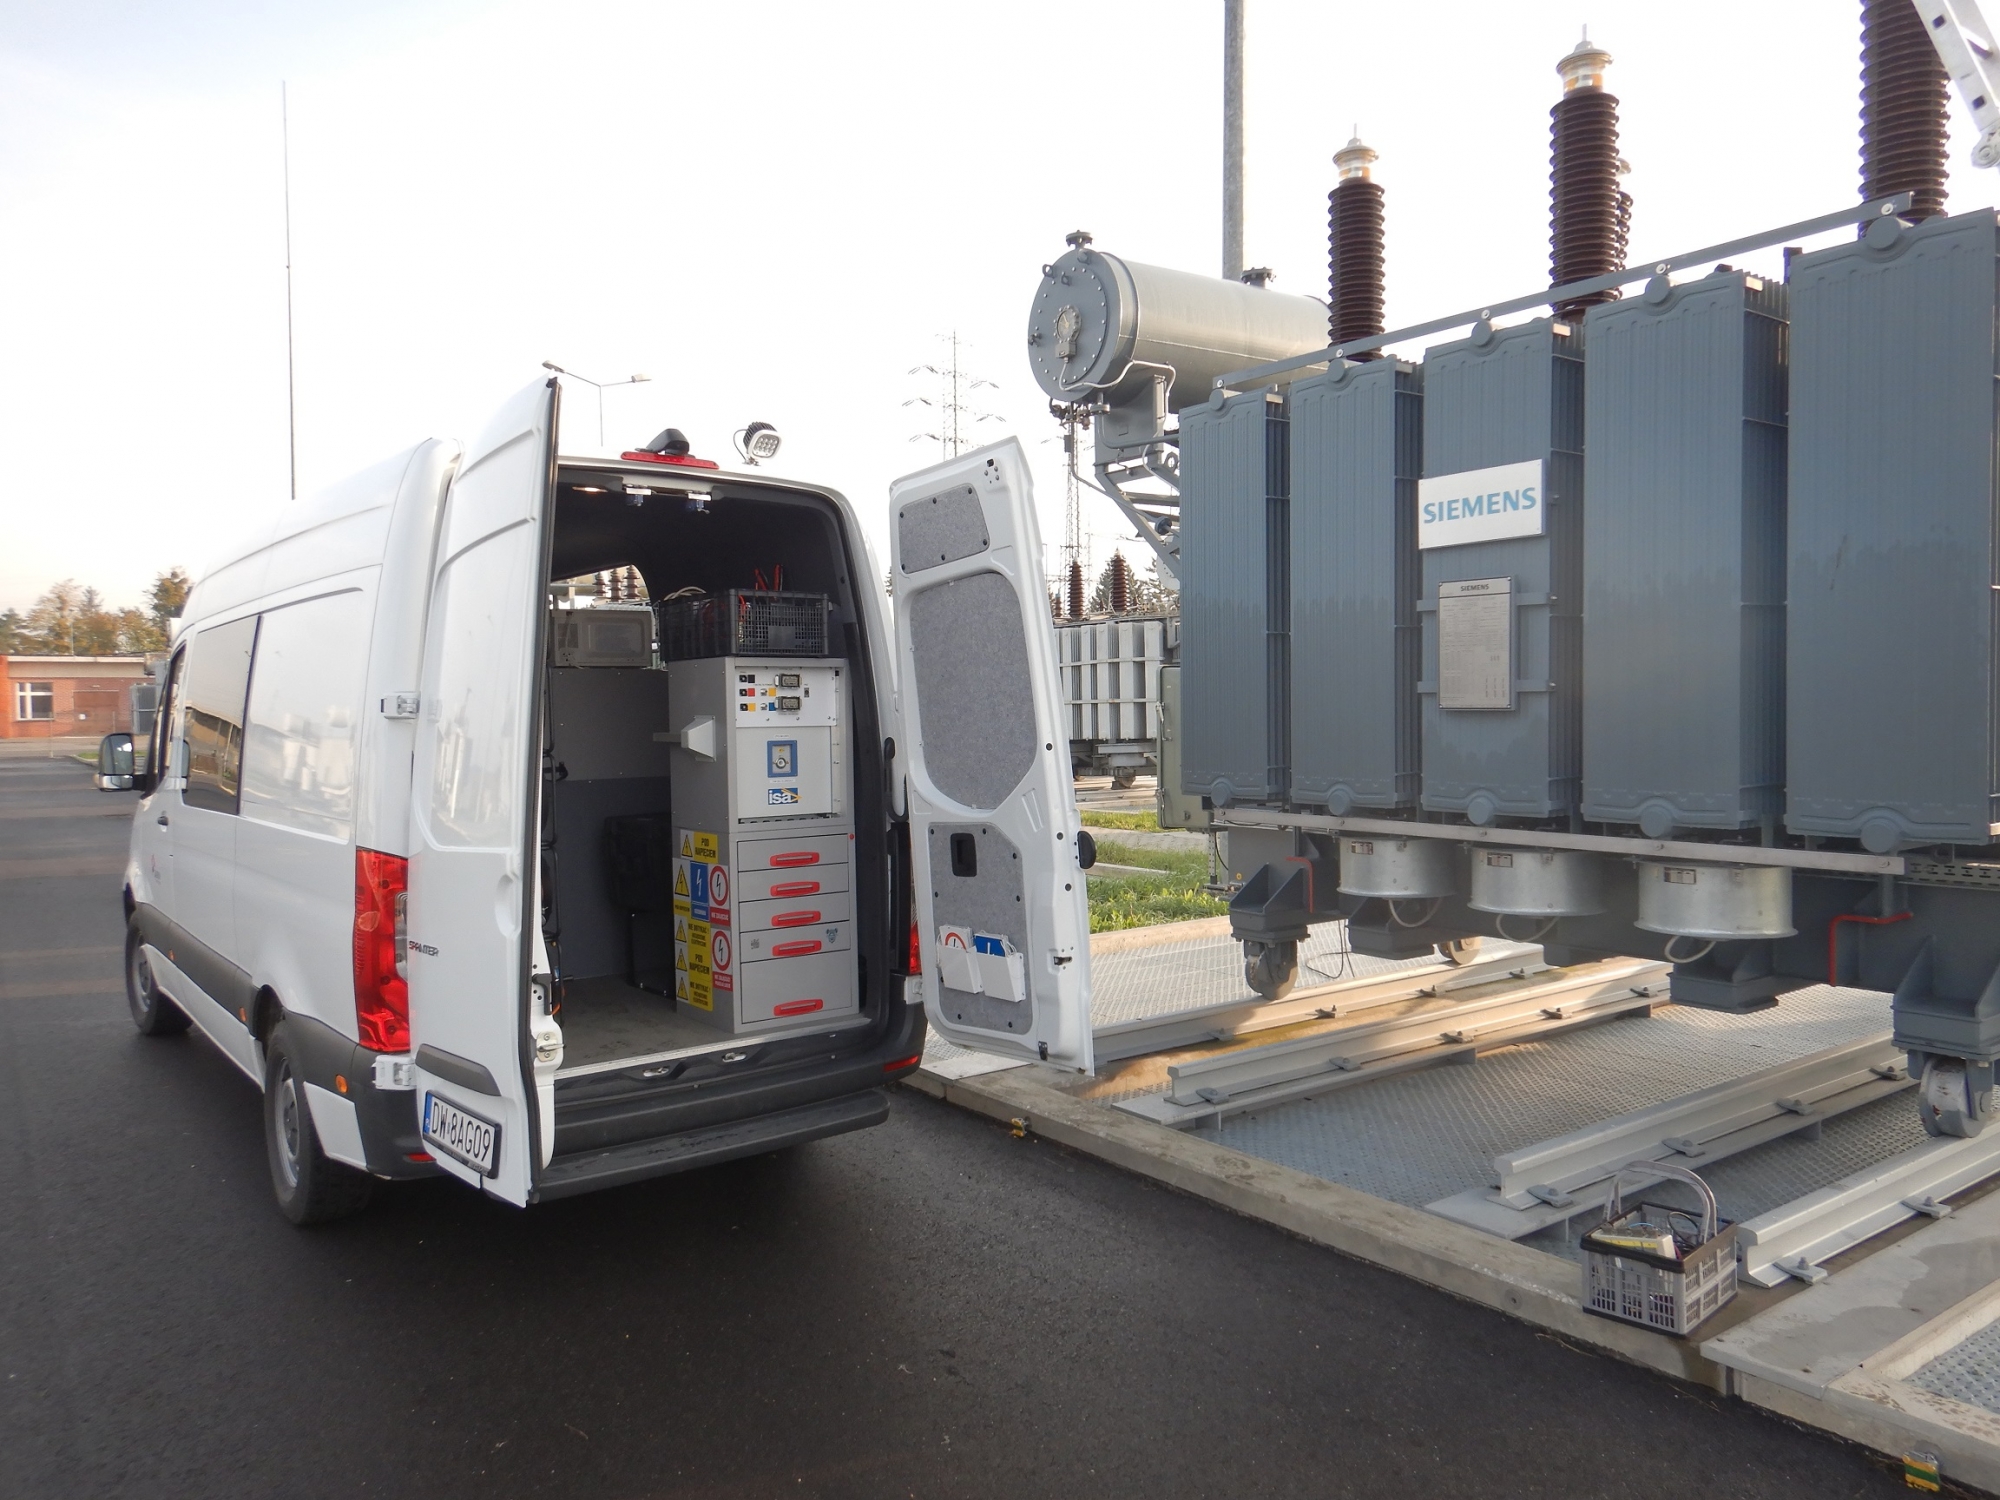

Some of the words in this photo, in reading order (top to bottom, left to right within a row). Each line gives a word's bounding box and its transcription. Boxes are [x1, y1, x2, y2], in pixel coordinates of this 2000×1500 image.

[1423, 487, 1537, 524] SIEMENS
[1460, 583, 1490, 592] SIEMENS
[432, 1101, 448, 1139] DW
[450, 1112, 491, 1162] 8AG09
